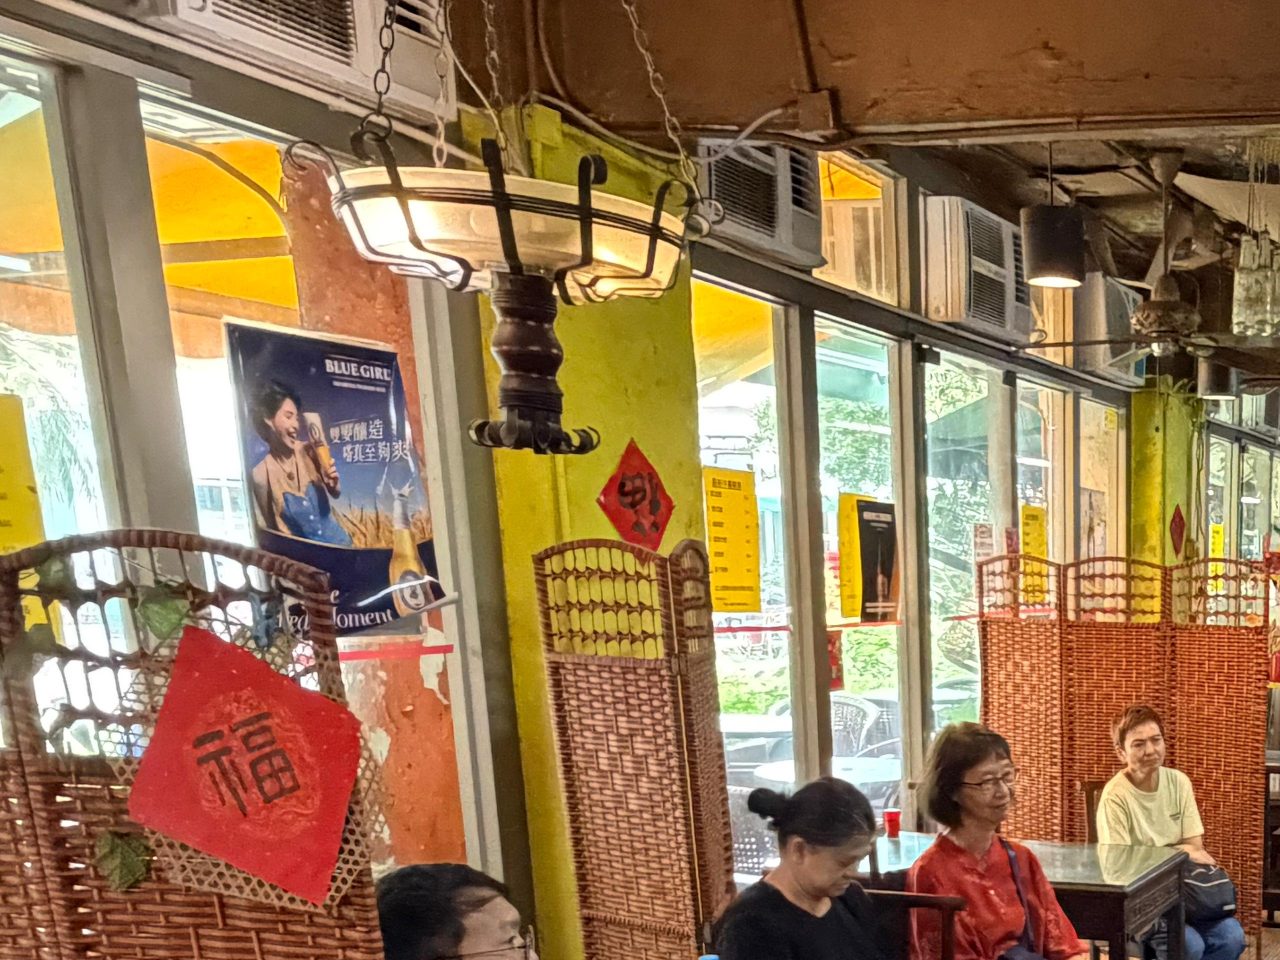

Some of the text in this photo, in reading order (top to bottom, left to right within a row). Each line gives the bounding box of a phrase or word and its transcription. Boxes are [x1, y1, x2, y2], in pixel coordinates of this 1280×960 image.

[325, 359, 392, 381] BLUE GIRL
[193, 711, 301, 818] 福
